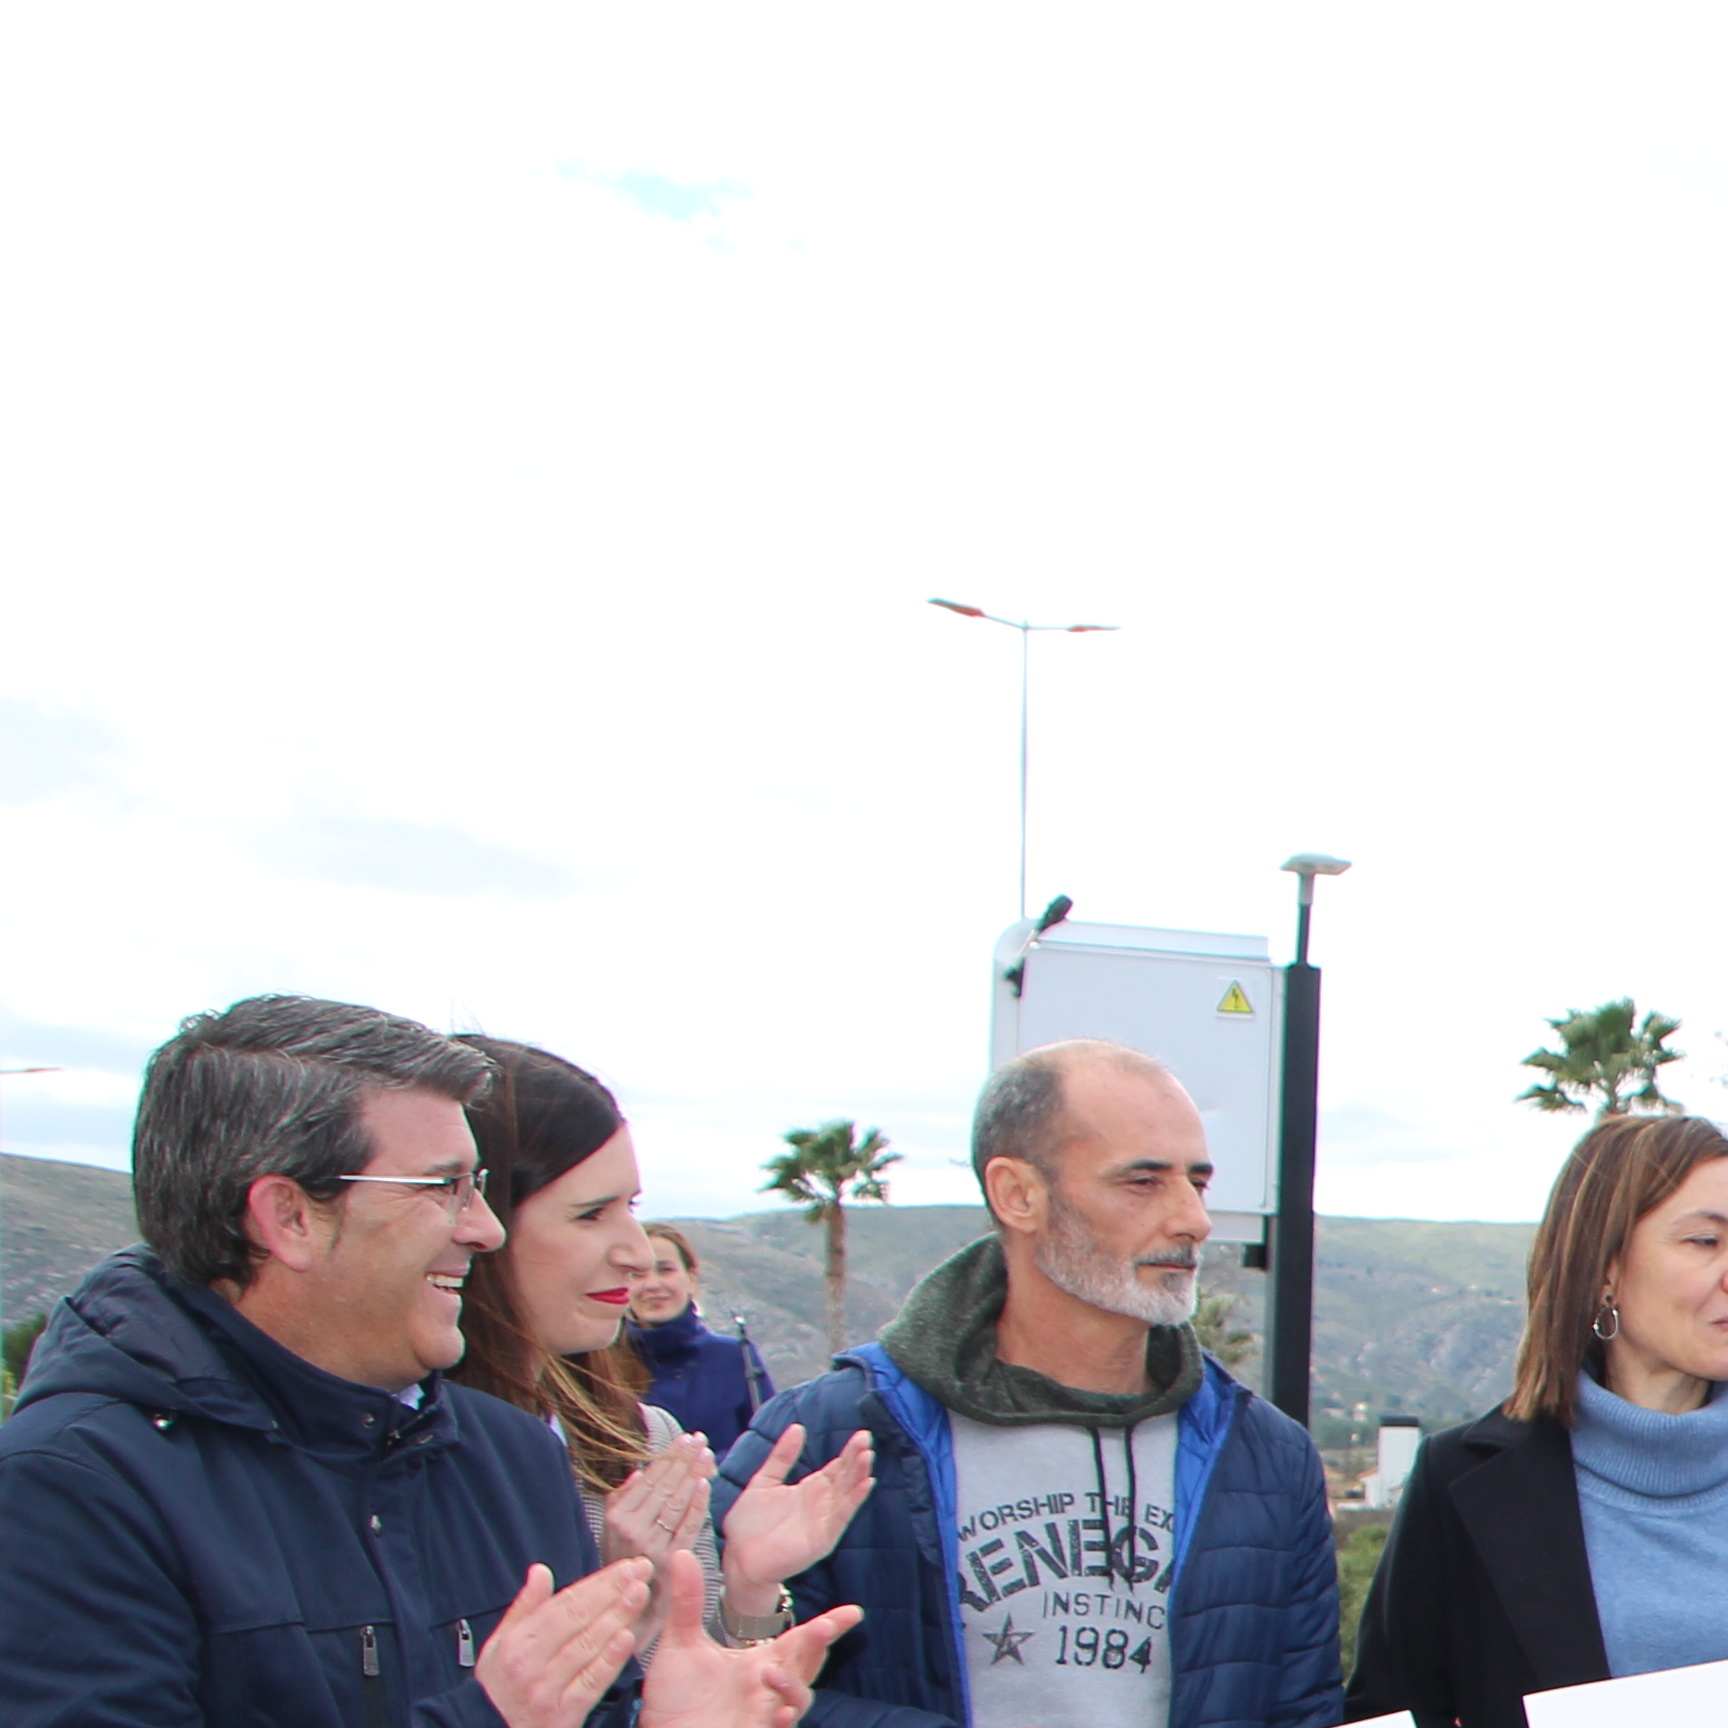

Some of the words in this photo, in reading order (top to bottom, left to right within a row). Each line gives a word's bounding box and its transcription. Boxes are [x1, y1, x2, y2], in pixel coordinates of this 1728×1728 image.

[958, 1493, 1075, 1541] WORSHIP
[1043, 1591, 1165, 1629] INSTINC
[1055, 1625, 1151, 1673] 1984
